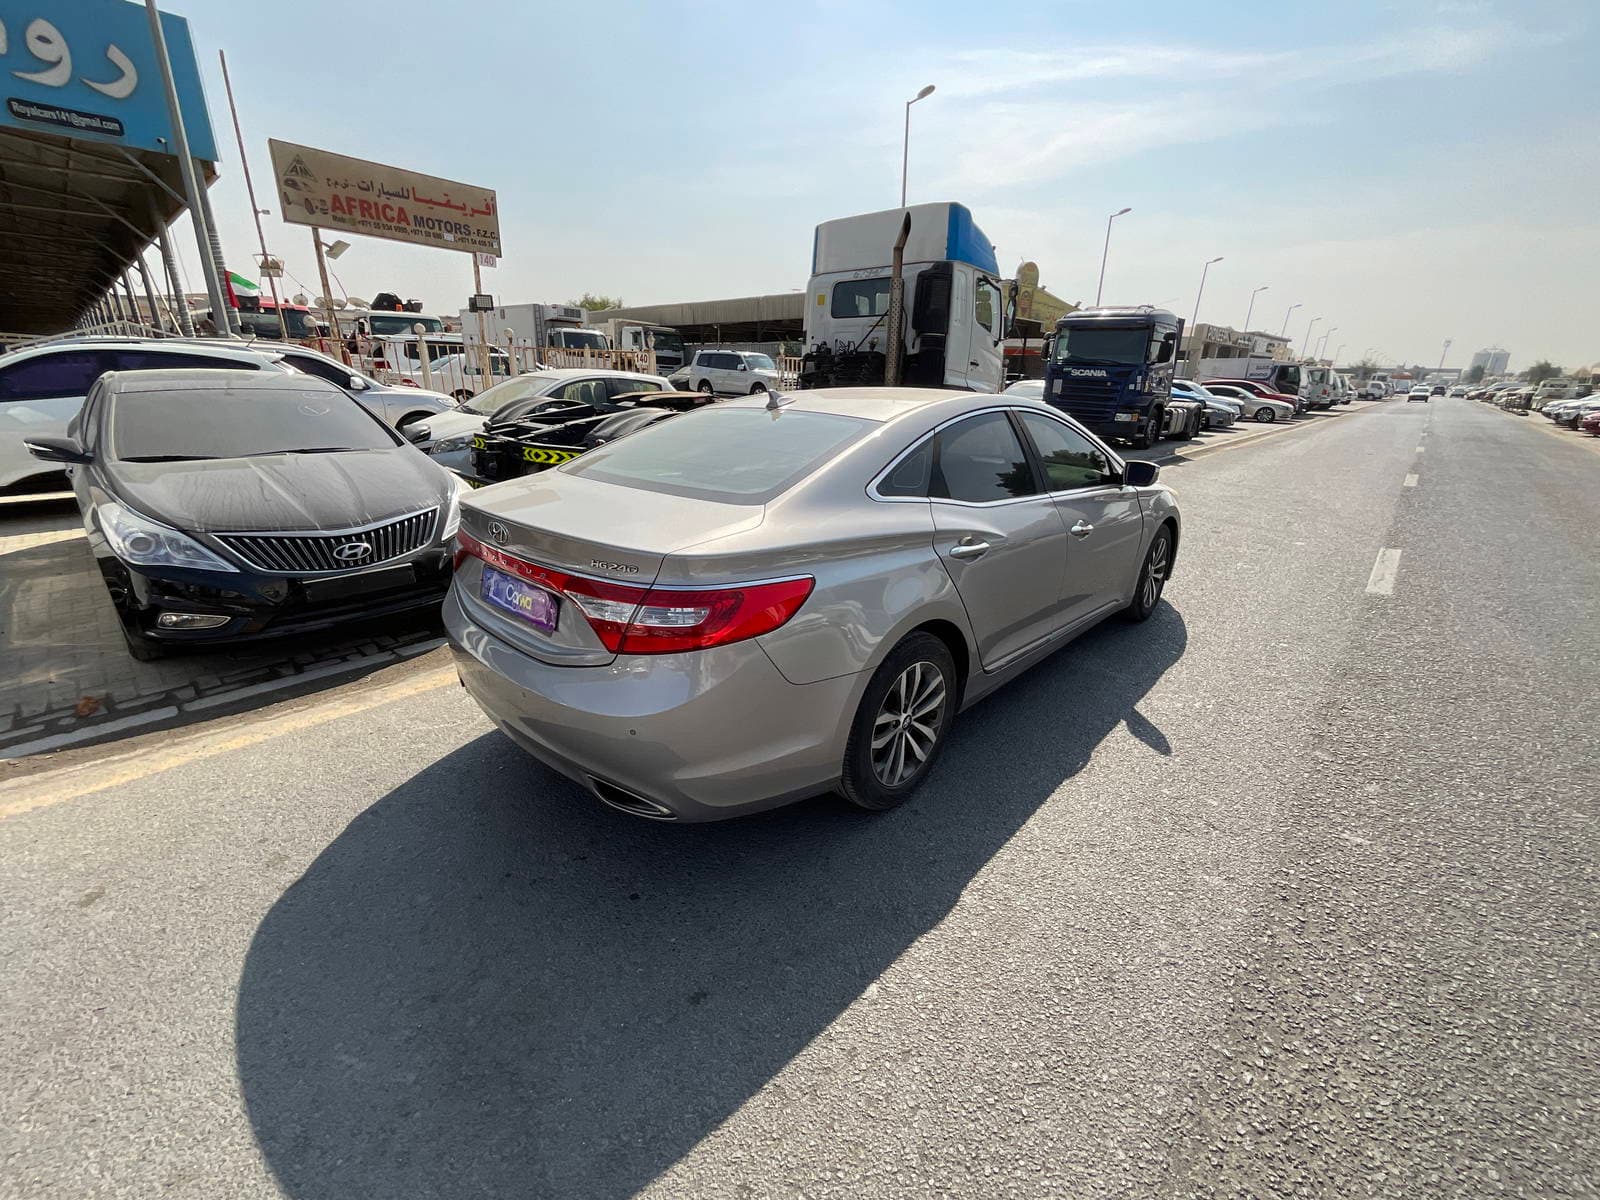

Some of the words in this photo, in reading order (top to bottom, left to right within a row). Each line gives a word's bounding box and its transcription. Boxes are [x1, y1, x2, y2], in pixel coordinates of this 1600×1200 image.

[10, 101, 120, 131] Royalcars141@gmail.com
[357, 180, 410, 201] للسيارات
[412, 187, 495, 217] أفريقيا
[331, 193, 411, 227] AFRICA
[413, 214, 472, 237] MOTORS
[476, 229, 499, 240] F.Z.C.
[479, 254, 494, 267] 140
[635, 353, 648, 364] 140
[1071, 368, 1107, 377] SCANIA
[590, 559, 640, 575] HG240
